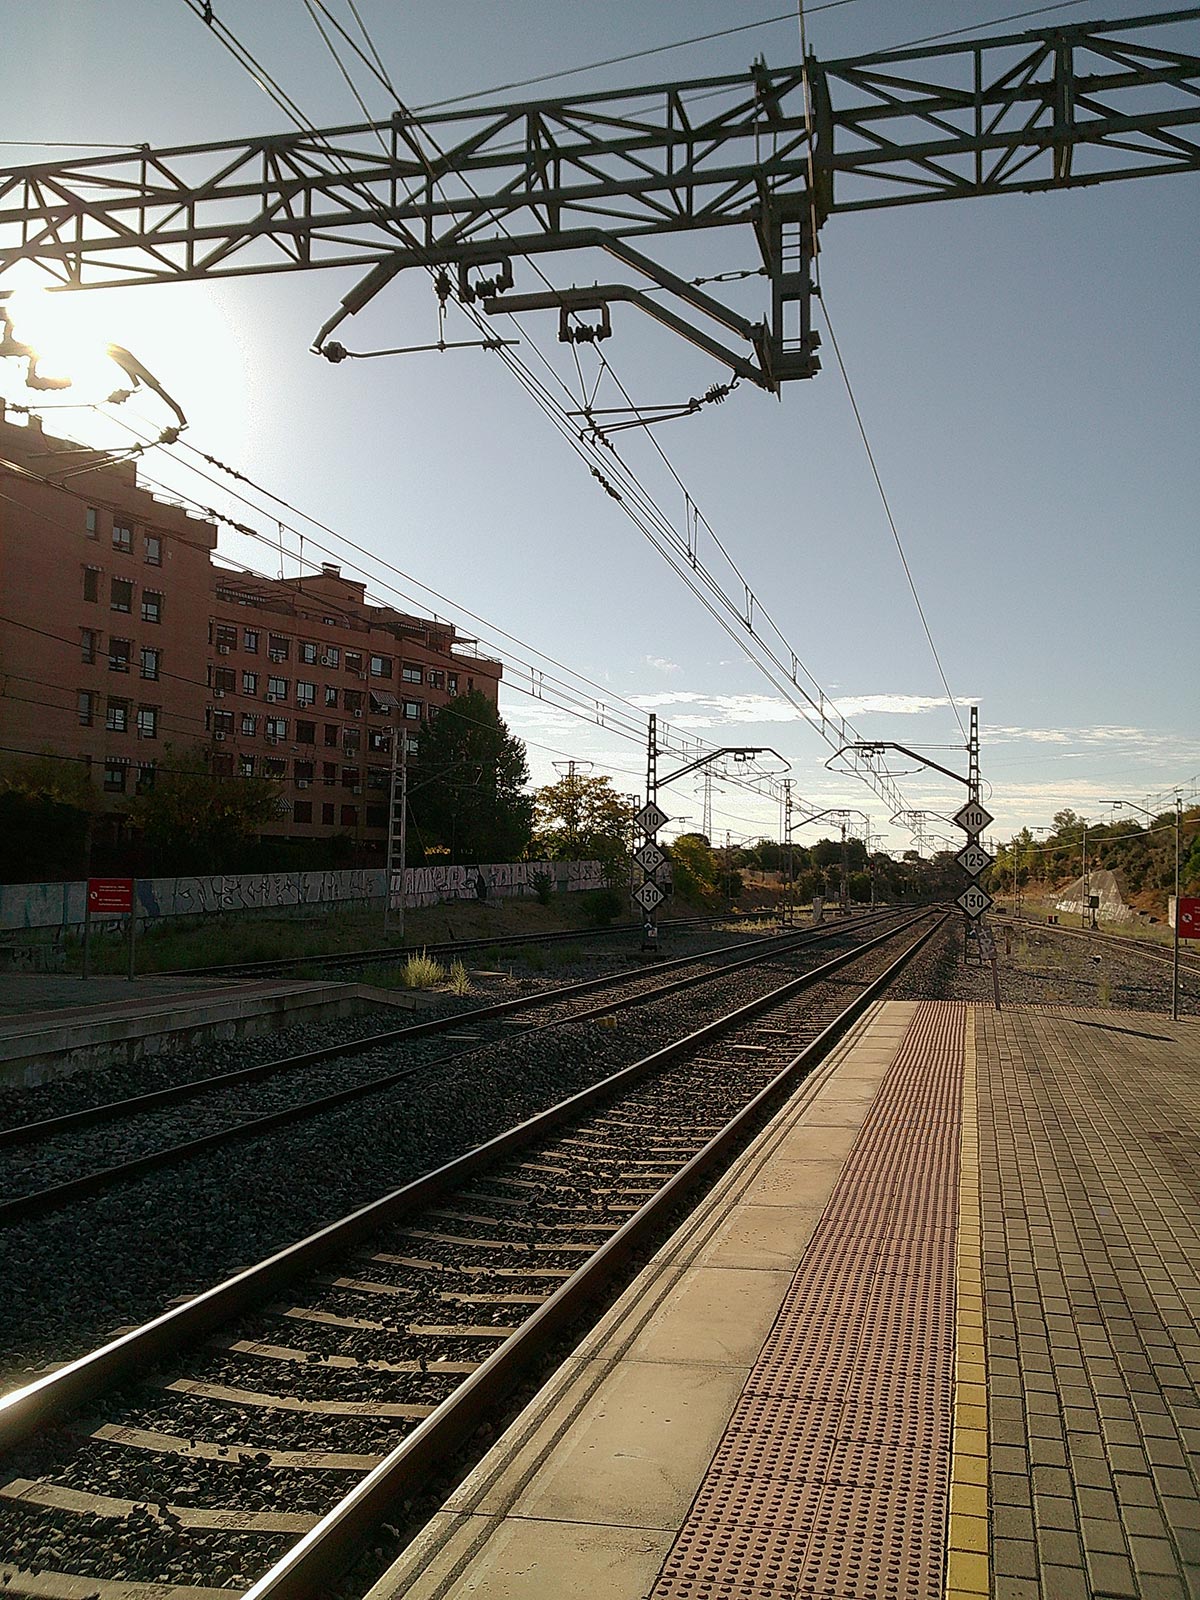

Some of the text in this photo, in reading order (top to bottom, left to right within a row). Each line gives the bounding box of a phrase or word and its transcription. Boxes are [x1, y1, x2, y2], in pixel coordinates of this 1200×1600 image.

[643, 813, 659, 826] 110
[965, 812, 983, 826] 110
[641, 851, 659, 864] 125
[963, 853, 984, 867] 125
[640, 890, 659, 903] 130
[963, 894, 984, 908] 130
